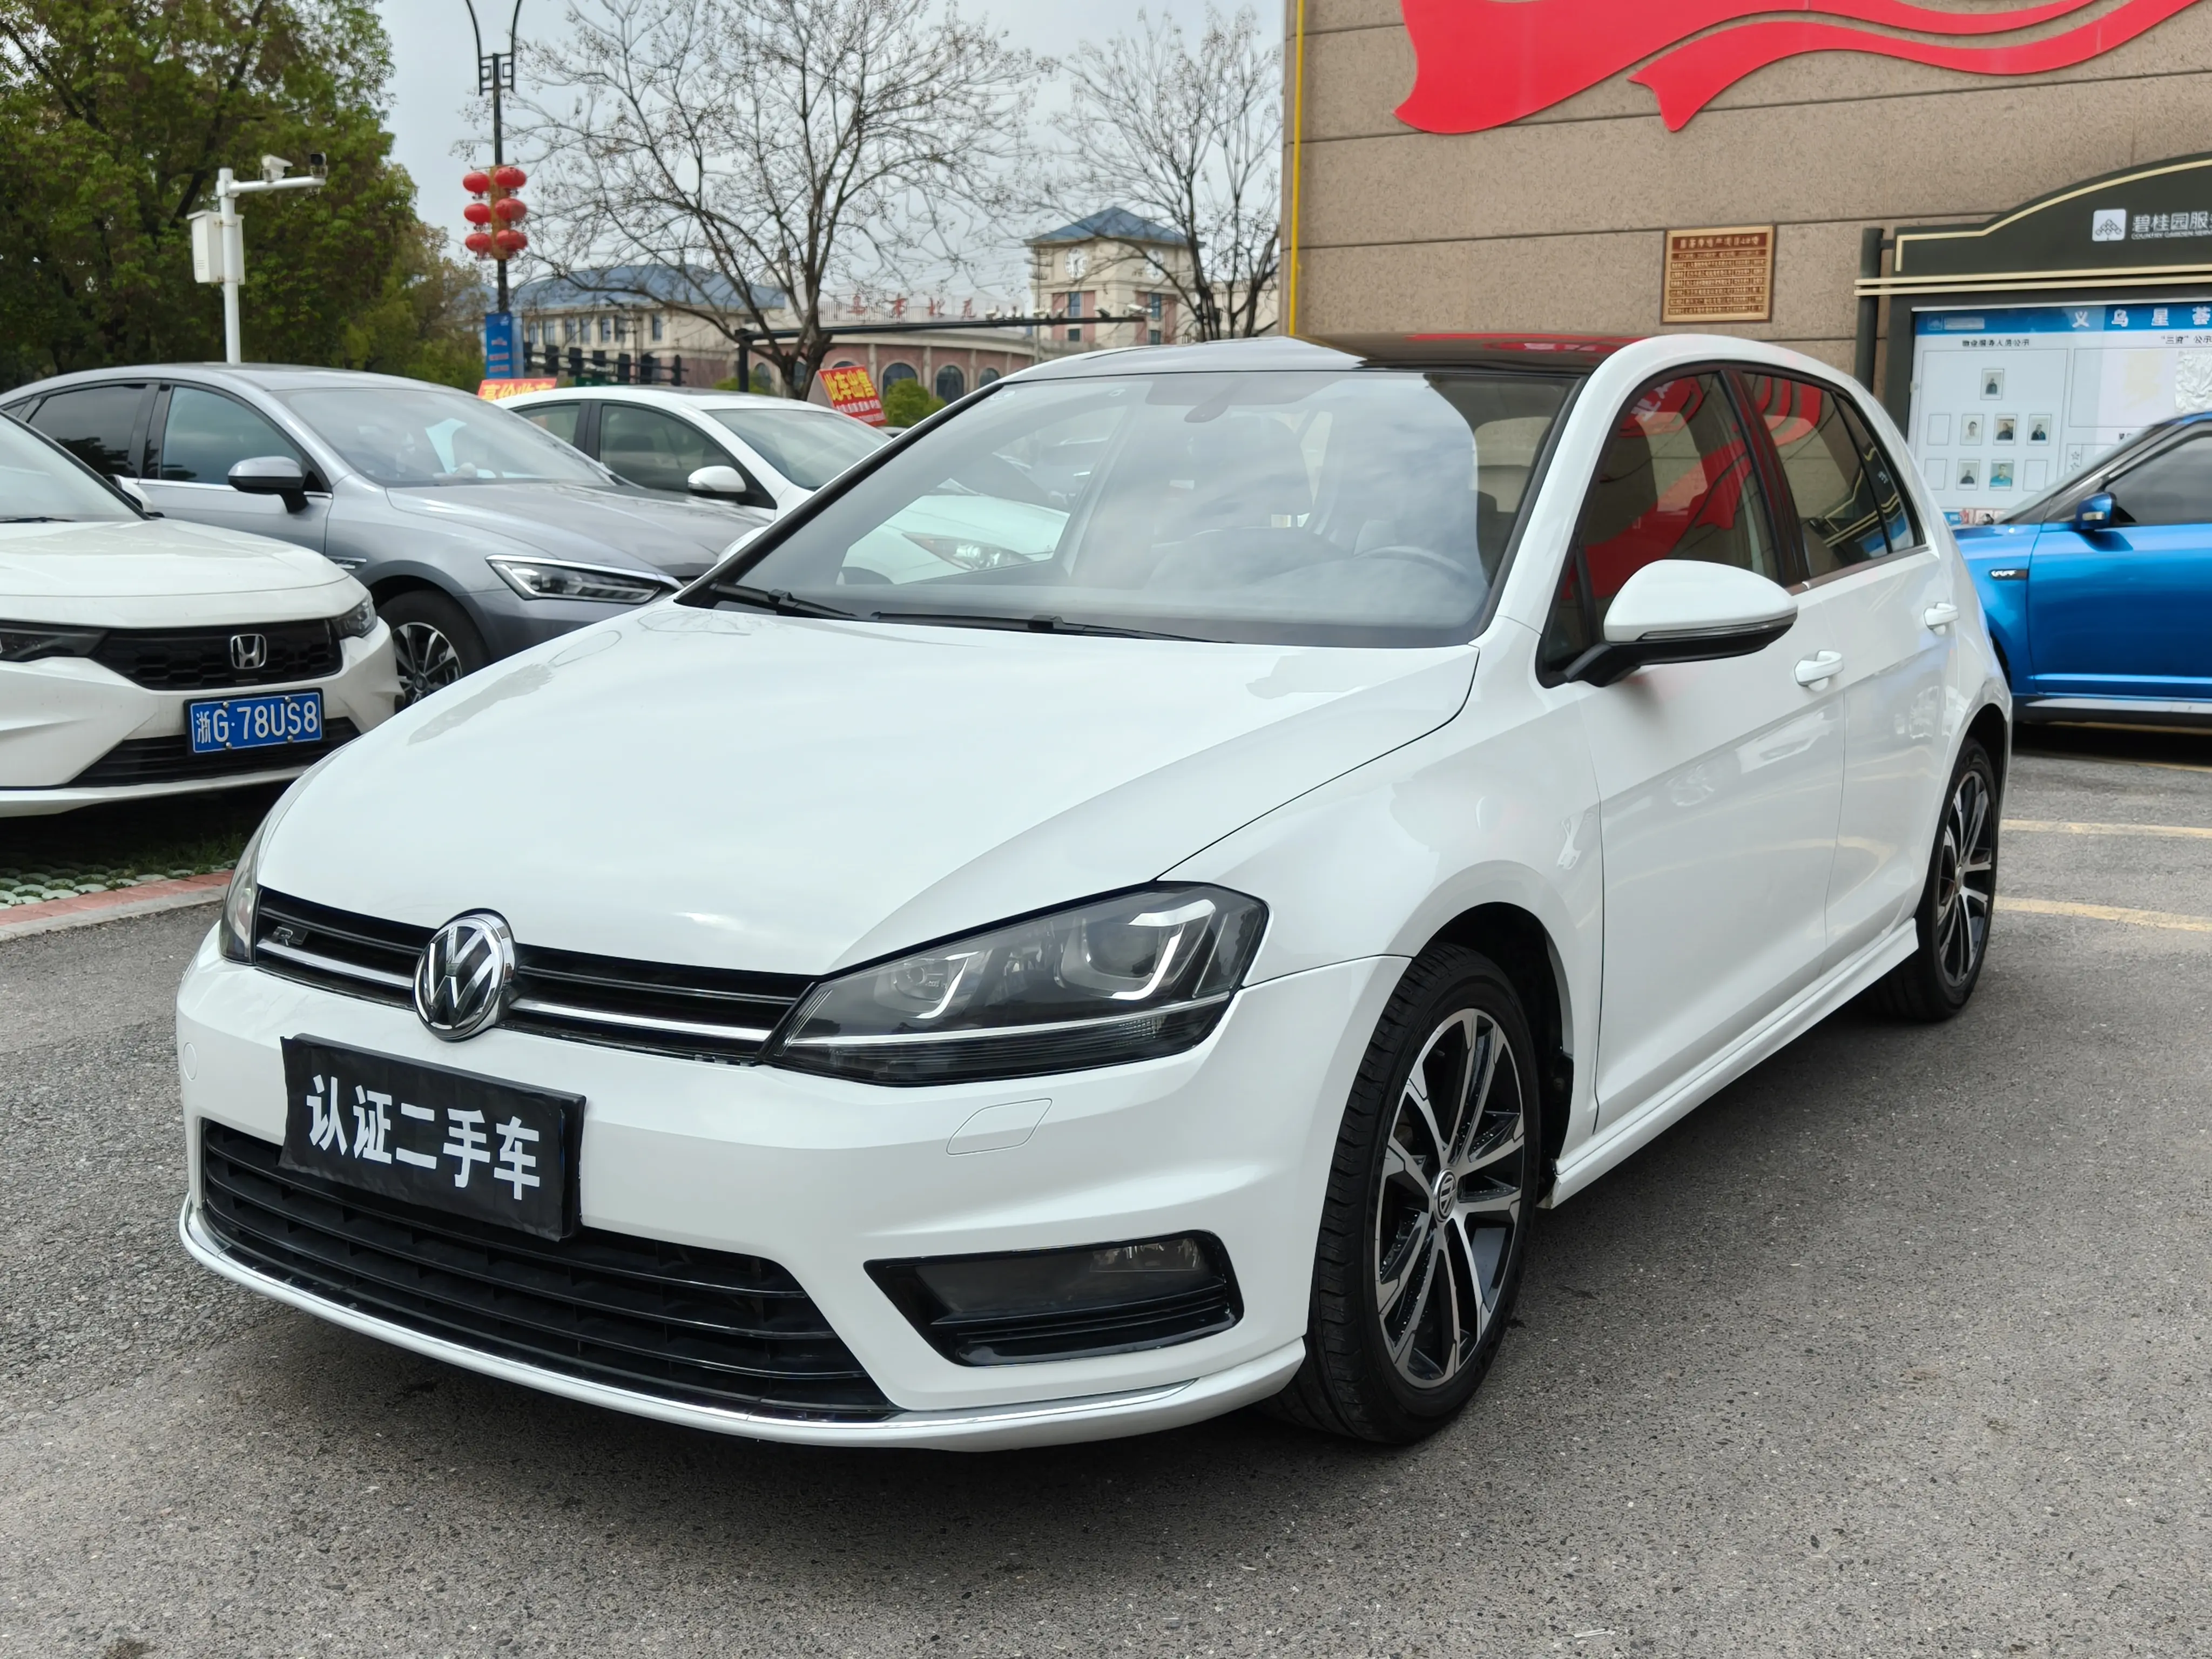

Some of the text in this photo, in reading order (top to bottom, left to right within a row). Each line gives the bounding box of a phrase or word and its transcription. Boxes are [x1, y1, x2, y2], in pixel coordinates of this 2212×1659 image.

[196, 700, 318, 744] 浙G·78US8
[306, 1074, 541, 1201] 认证二手车
